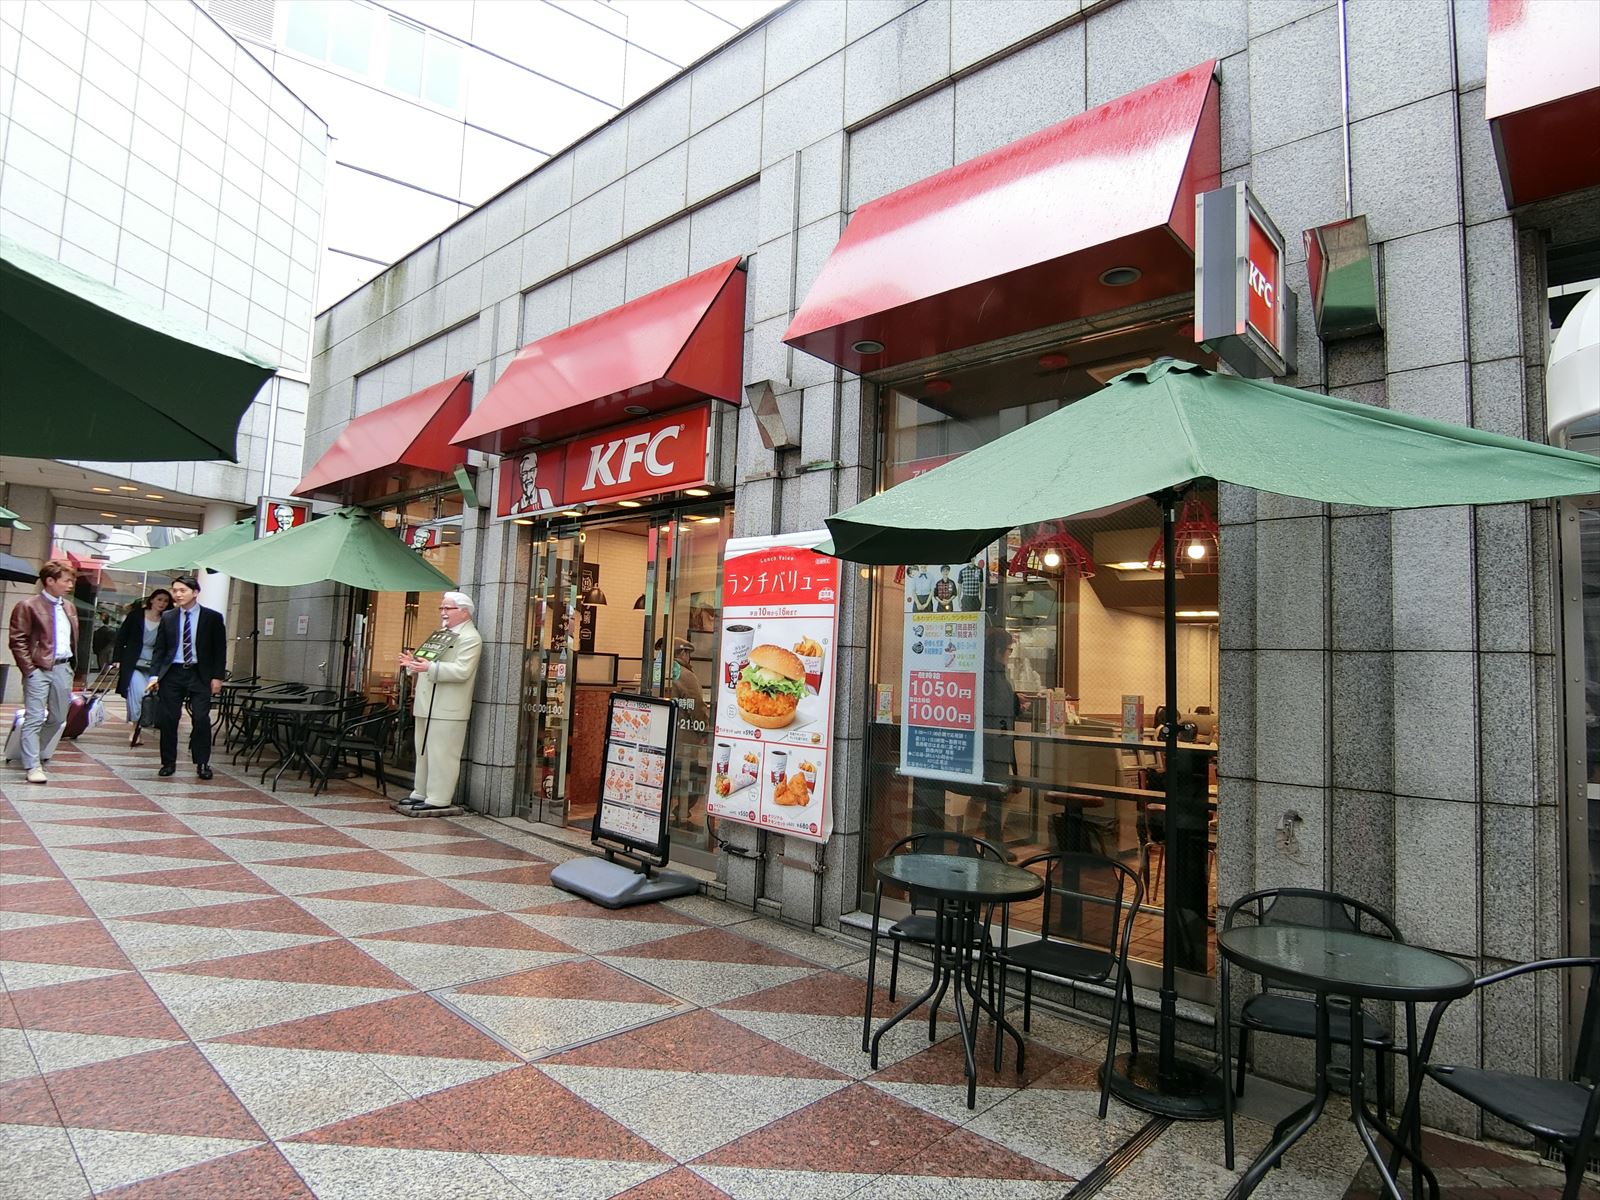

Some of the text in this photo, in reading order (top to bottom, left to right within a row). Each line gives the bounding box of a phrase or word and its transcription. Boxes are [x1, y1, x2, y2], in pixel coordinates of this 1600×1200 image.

[1249, 260, 1273, 309] KFC
[581, 425, 680, 491] KFC
[728, 570, 830, 595] ランチバリュー
